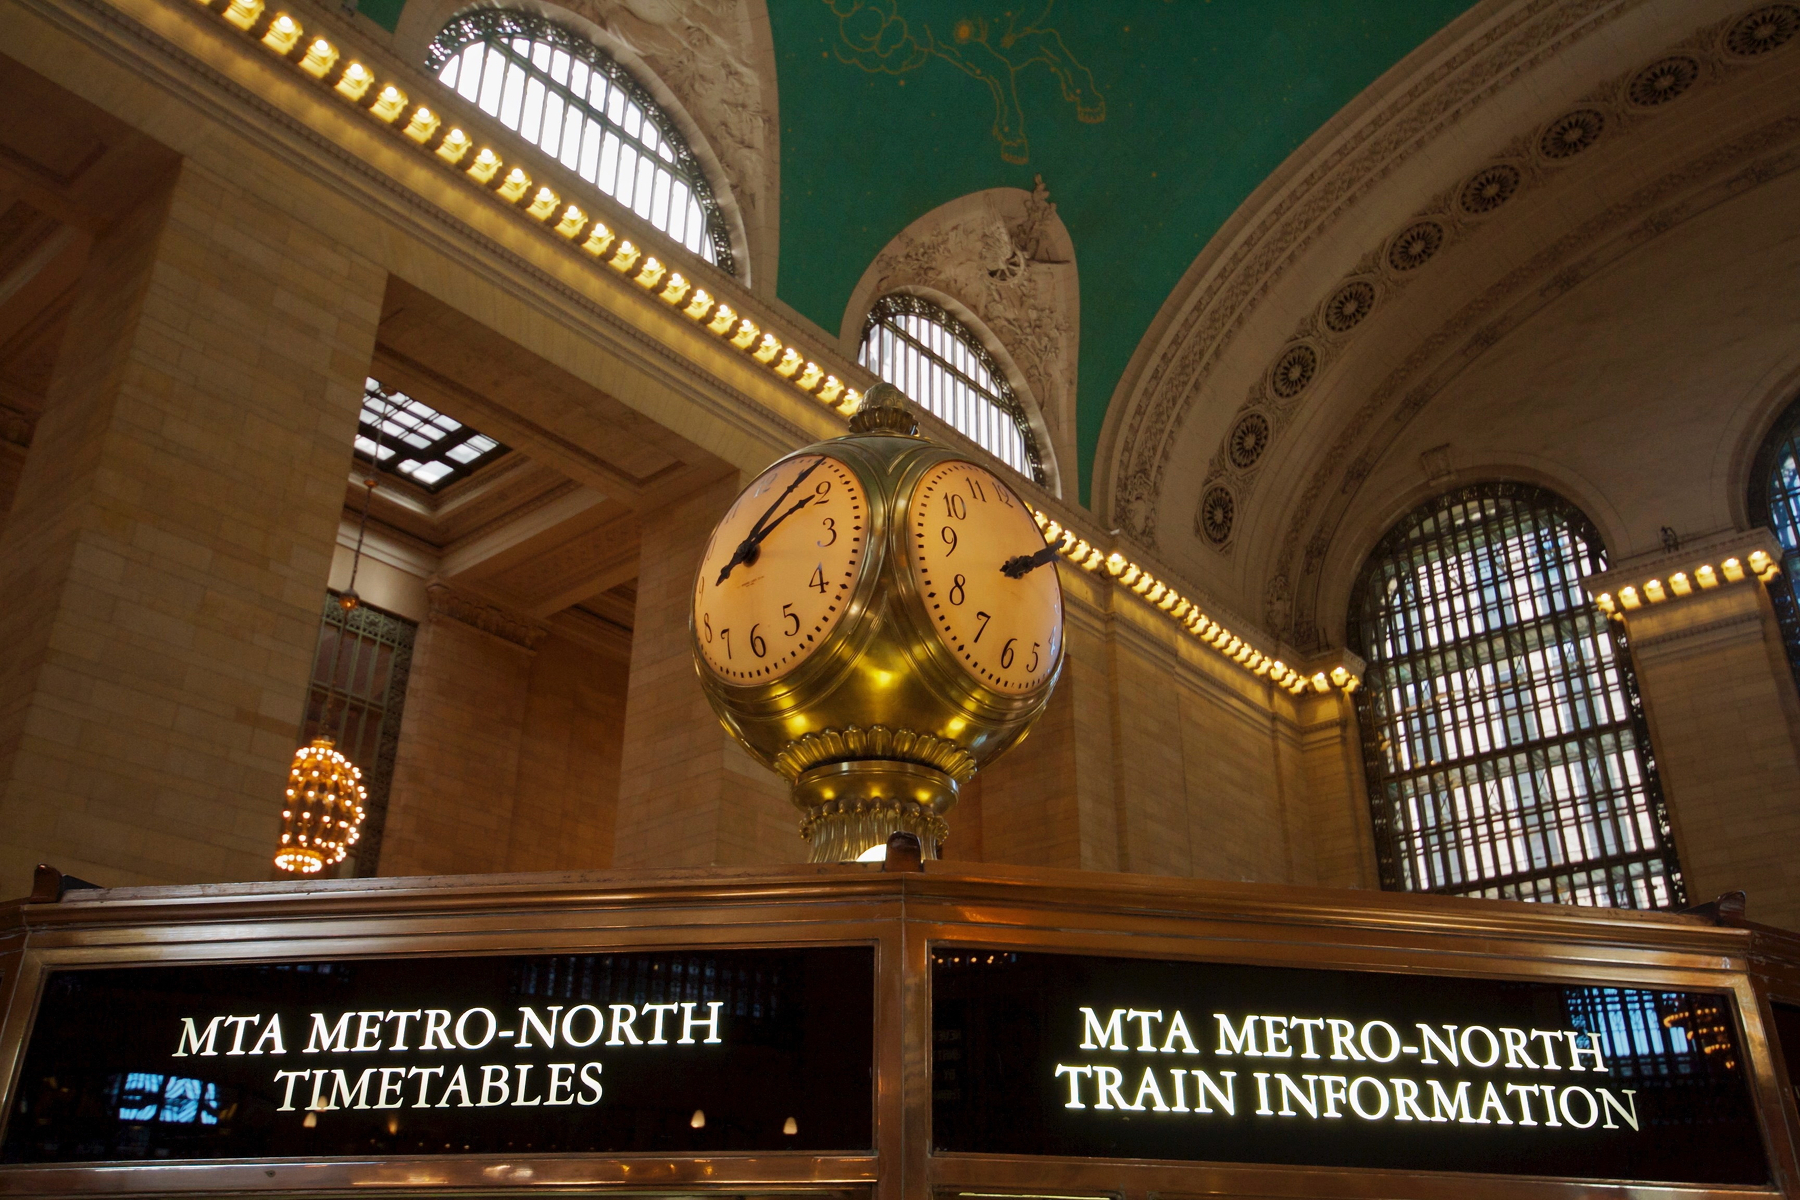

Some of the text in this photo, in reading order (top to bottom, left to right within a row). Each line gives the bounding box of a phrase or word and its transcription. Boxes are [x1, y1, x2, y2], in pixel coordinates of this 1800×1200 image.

[813, 481, 832, 506] 2
[943, 492, 967, 520] 10
[965, 477, 987, 503] 11
[992, 482, 1014, 508] 12
[817, 517, 838, 547] 3
[941, 526, 958, 557] 9
[808, 562, 830, 594] 4
[949, 574, 966, 606] 8
[703, 613, 713, 644] 8
[782, 603, 800, 637] 5
[974, 611, 991, 643] 7
[720, 628, 732, 660] 7
[750, 623, 767, 658] 6
[1000, 638, 1018, 669] 6
[1026, 642, 1040, 673] 5
[171, 1001, 725, 1057] MTA METRO-NORTH
[1078, 1006, 1608, 1073] MTA METRO-NORTH
[272, 1061, 604, 1113] TIMETABLES
[1054, 1062, 1640, 1132] TRAIN INFORMATION
